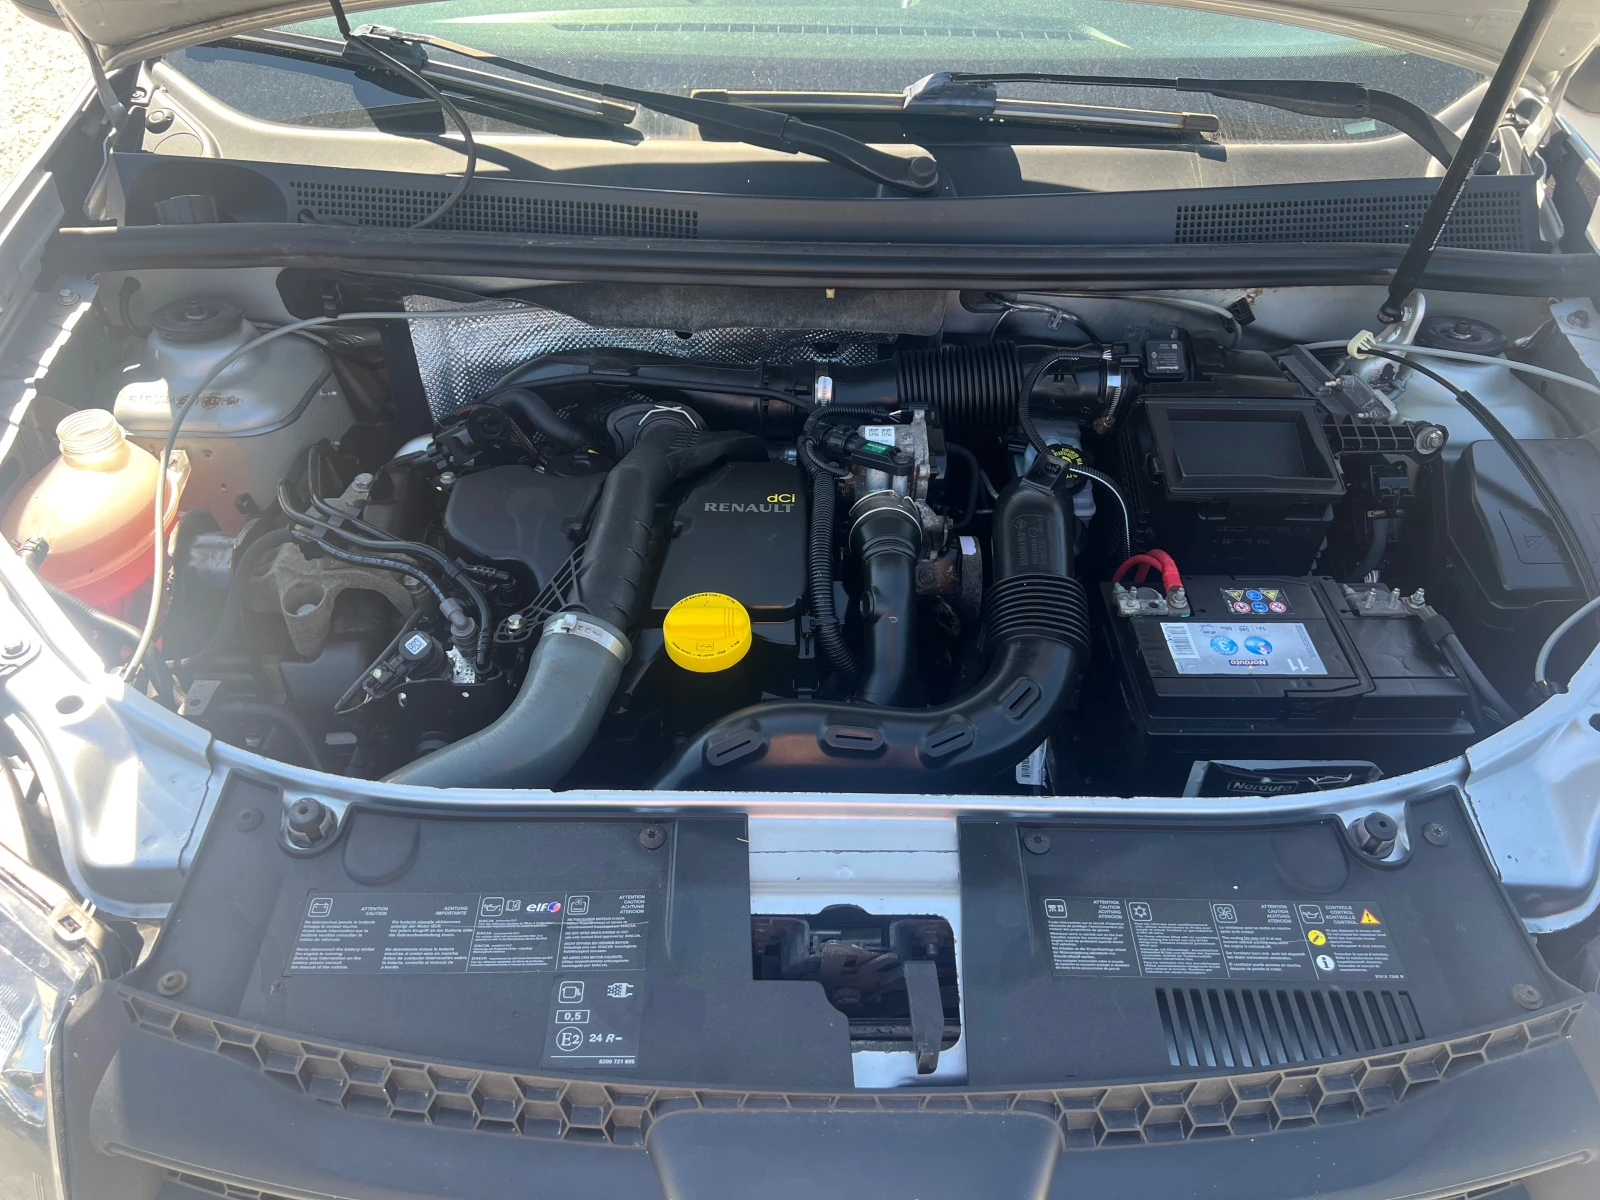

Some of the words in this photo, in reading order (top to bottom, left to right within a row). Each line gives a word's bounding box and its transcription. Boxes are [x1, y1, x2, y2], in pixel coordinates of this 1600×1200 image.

[704, 502, 794, 512] RENAULT
[1218, 641, 1229, 651] 3
[1287, 658, 1308, 672] 11
[1233, 782, 1293, 791] Norauto
[526, 903, 548, 912] elf
[564, 1012, 581, 1021] 0,5
[561, 1032, 580, 1046] E2
[589, 1034, 602, 1042] 24
